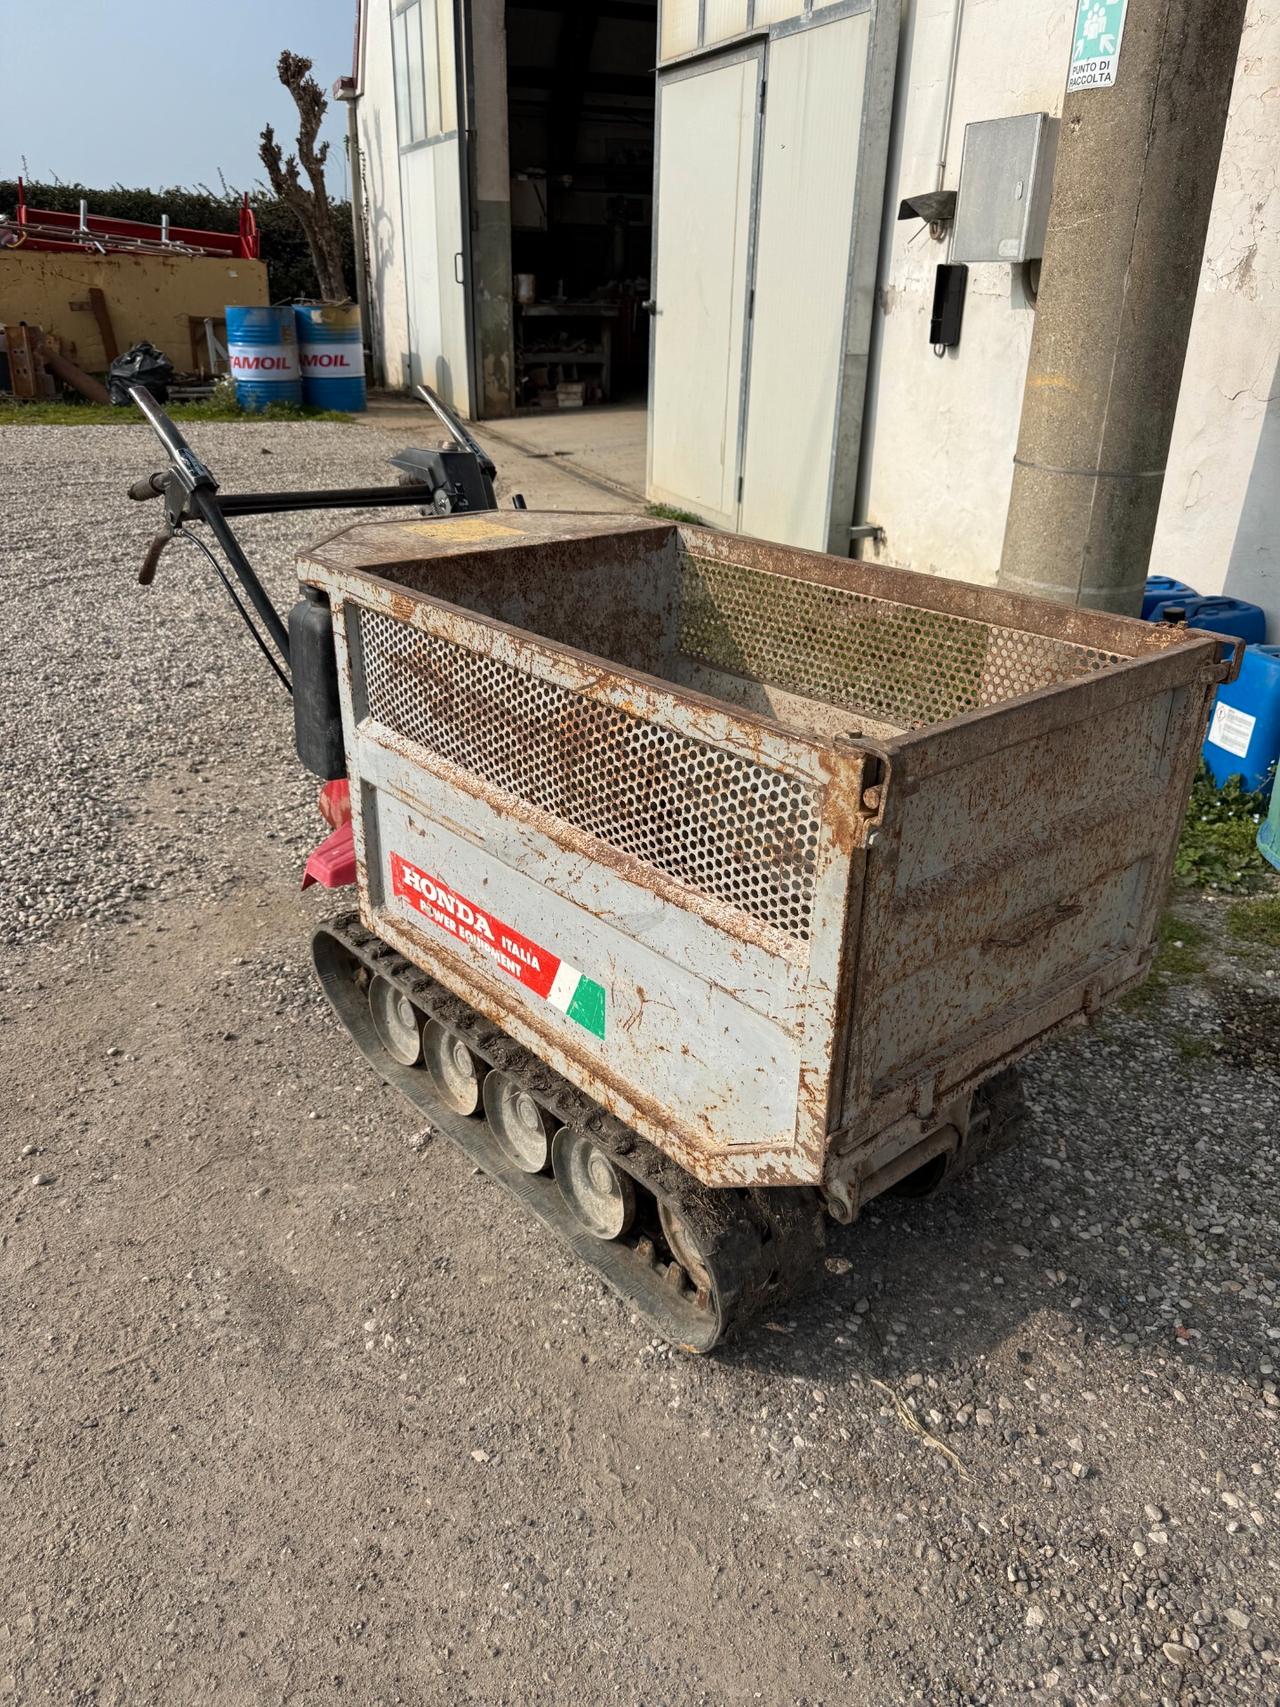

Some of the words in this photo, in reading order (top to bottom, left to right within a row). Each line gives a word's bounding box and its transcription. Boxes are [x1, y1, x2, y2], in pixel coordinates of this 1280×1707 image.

[1069, 73, 1111, 87] RACCOLTA
[1072, 62, 1097, 75] PUNTO
[1100, 61, 1110, 70] DI
[402, 866, 495, 941] HONDA
[502, 935, 541, 972] ITALIA
[458, 924, 522, 977] EQUIPMENT
